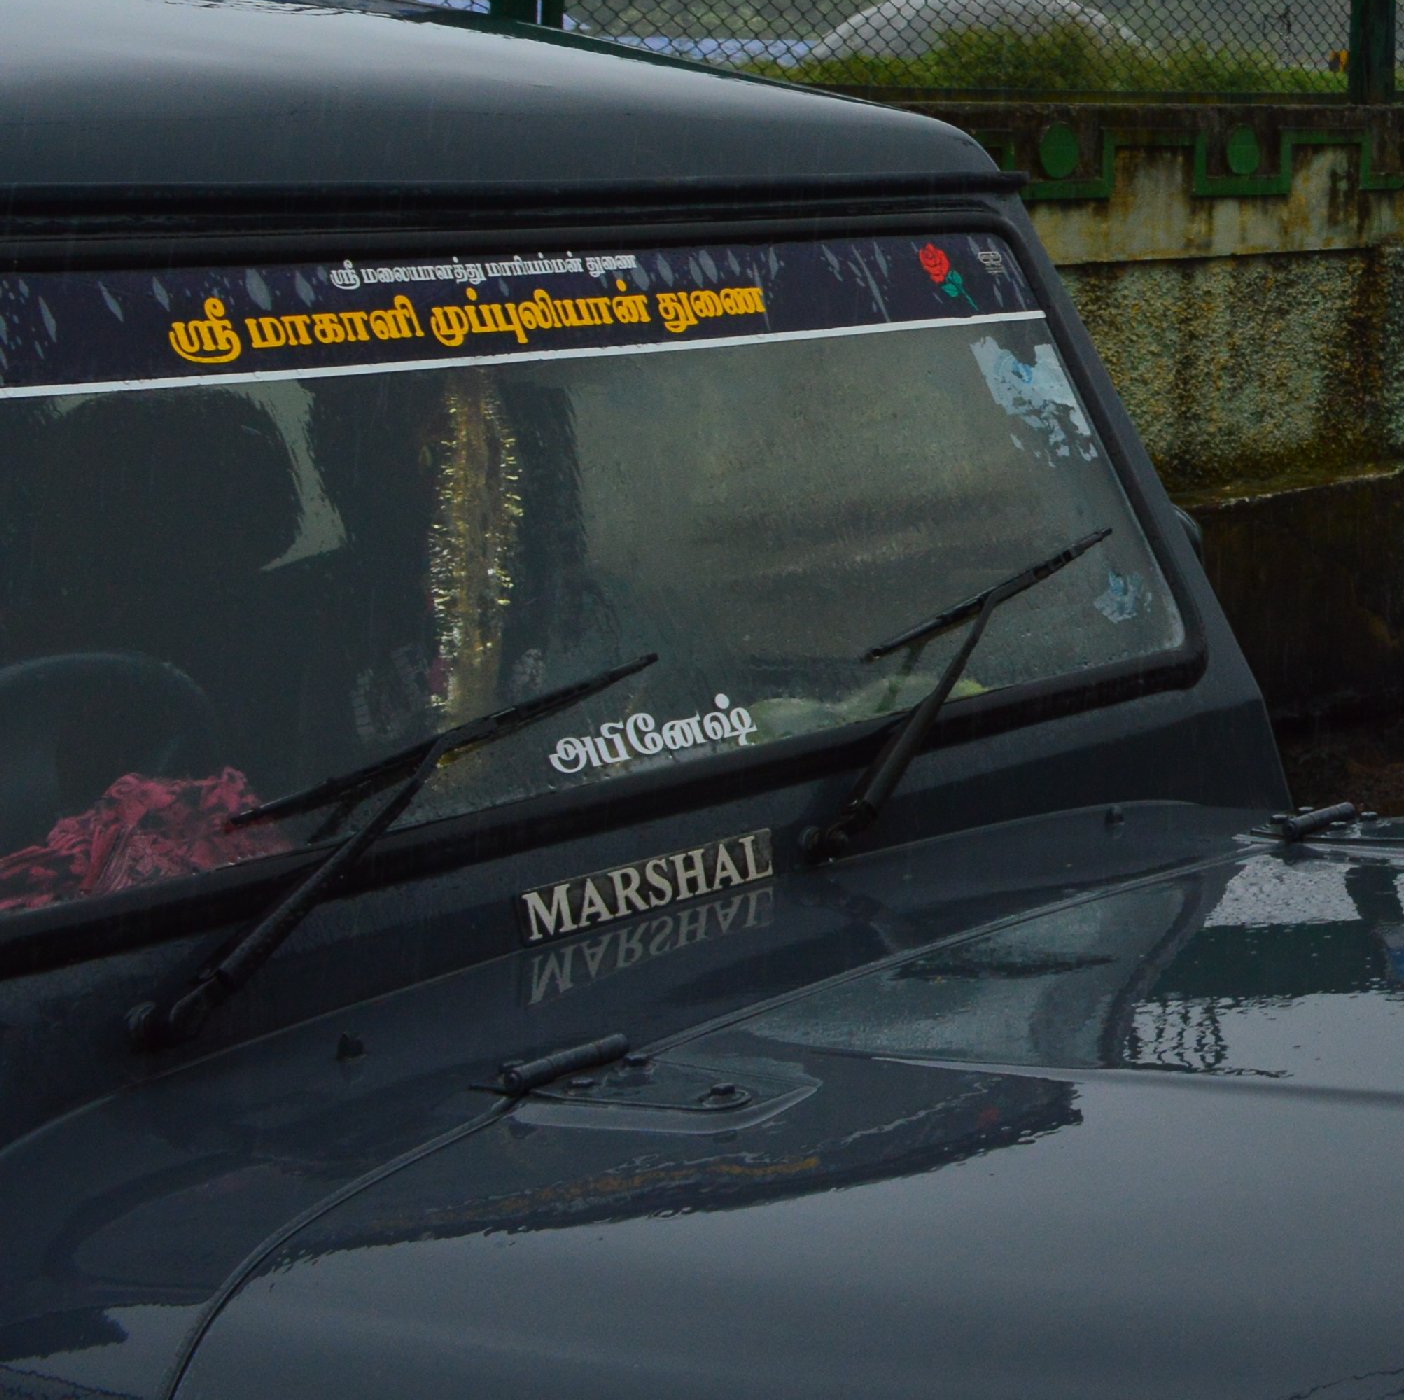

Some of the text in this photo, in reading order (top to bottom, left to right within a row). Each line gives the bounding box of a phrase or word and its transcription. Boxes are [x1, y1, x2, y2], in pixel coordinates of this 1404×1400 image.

[586, 254, 637, 277] துணை
[169, 280, 766, 363] ஸ்ரீ மாகாளி முப்புலியான் துணை
[549, 693, 757, 773] அபினேஷ்
[521, 835, 774, 941] MARSHAL
